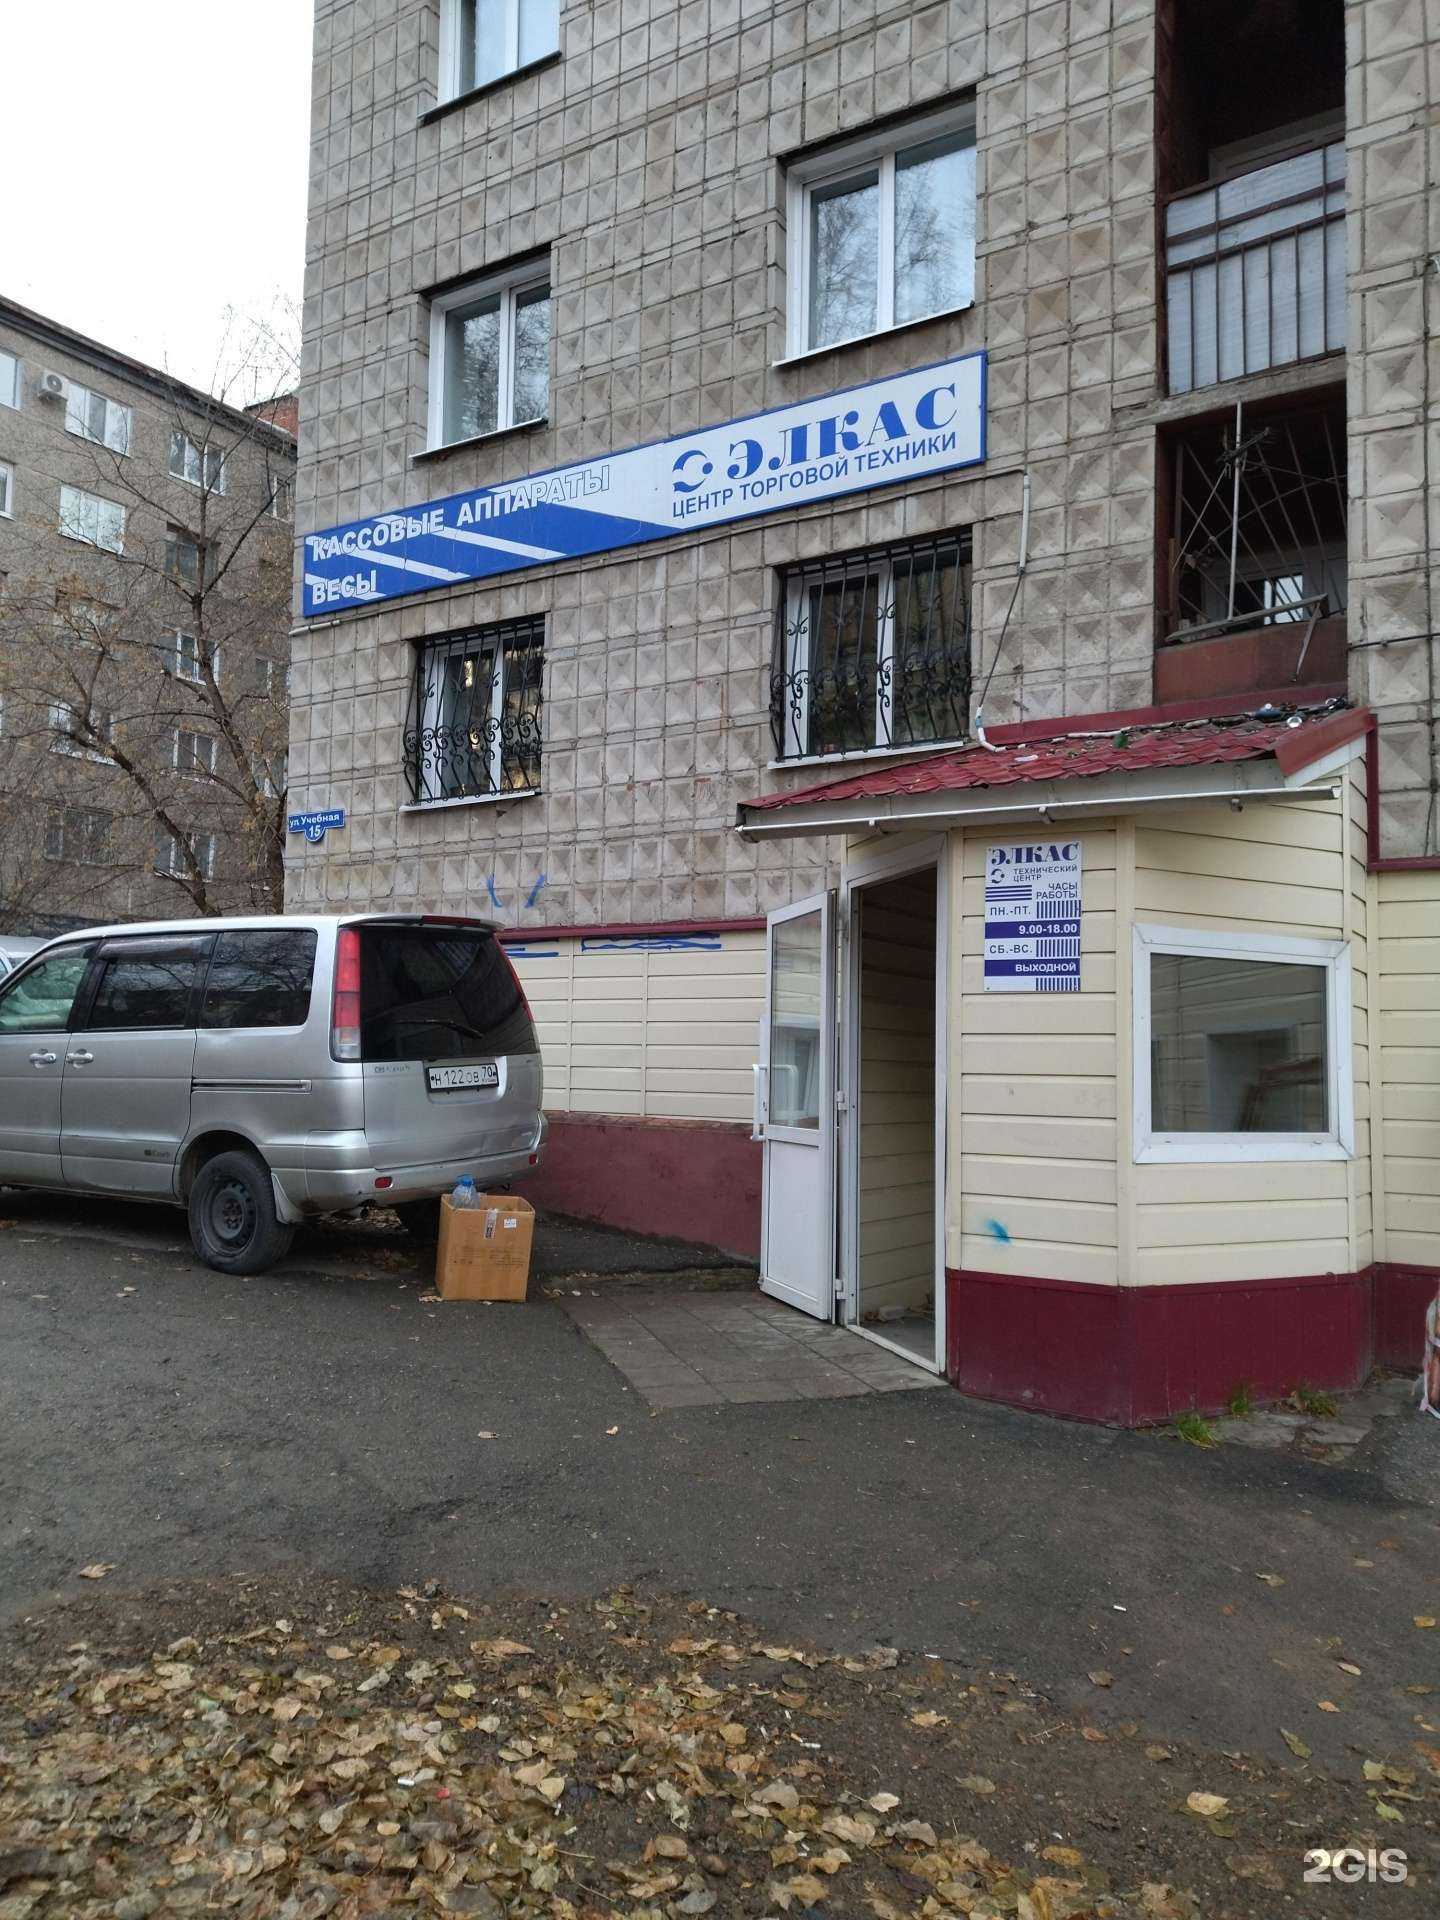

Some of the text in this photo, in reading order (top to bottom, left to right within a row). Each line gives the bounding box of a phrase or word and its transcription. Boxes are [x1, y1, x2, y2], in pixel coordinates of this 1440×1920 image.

[727, 383, 957, 480] ЭЛКАС
[673, 431, 956, 519] ЦЕНТР ТОРГОВОЙ ТЕХНИКИ
[312, 464, 610, 561] КАССОВЫЕ АППАРАТЫ
[311, 570, 376, 605] ВЕСЫ
[301, 814, 340, 825] Учебная
[309, 825, 321, 837] 15
[991, 842, 1079, 865] ЭЛКАС
[1013, 864, 1078, 875] ТЕХНИЧЕСКИЙ
[1013, 874, 1042, 882] ЦЕНТР
[1048, 882, 1078, 890] ЧАСЫ
[1036, 890, 1078, 899] РАБОТЫ
[990, 906, 1031, 916] ПН.-ПТ.
[1018, 923, 1078, 934] 9.00-18.00
[989, 944, 1033, 954] СБ.-ВС.
[1015, 962, 1077, 972] ВЫХОДНОЙ
